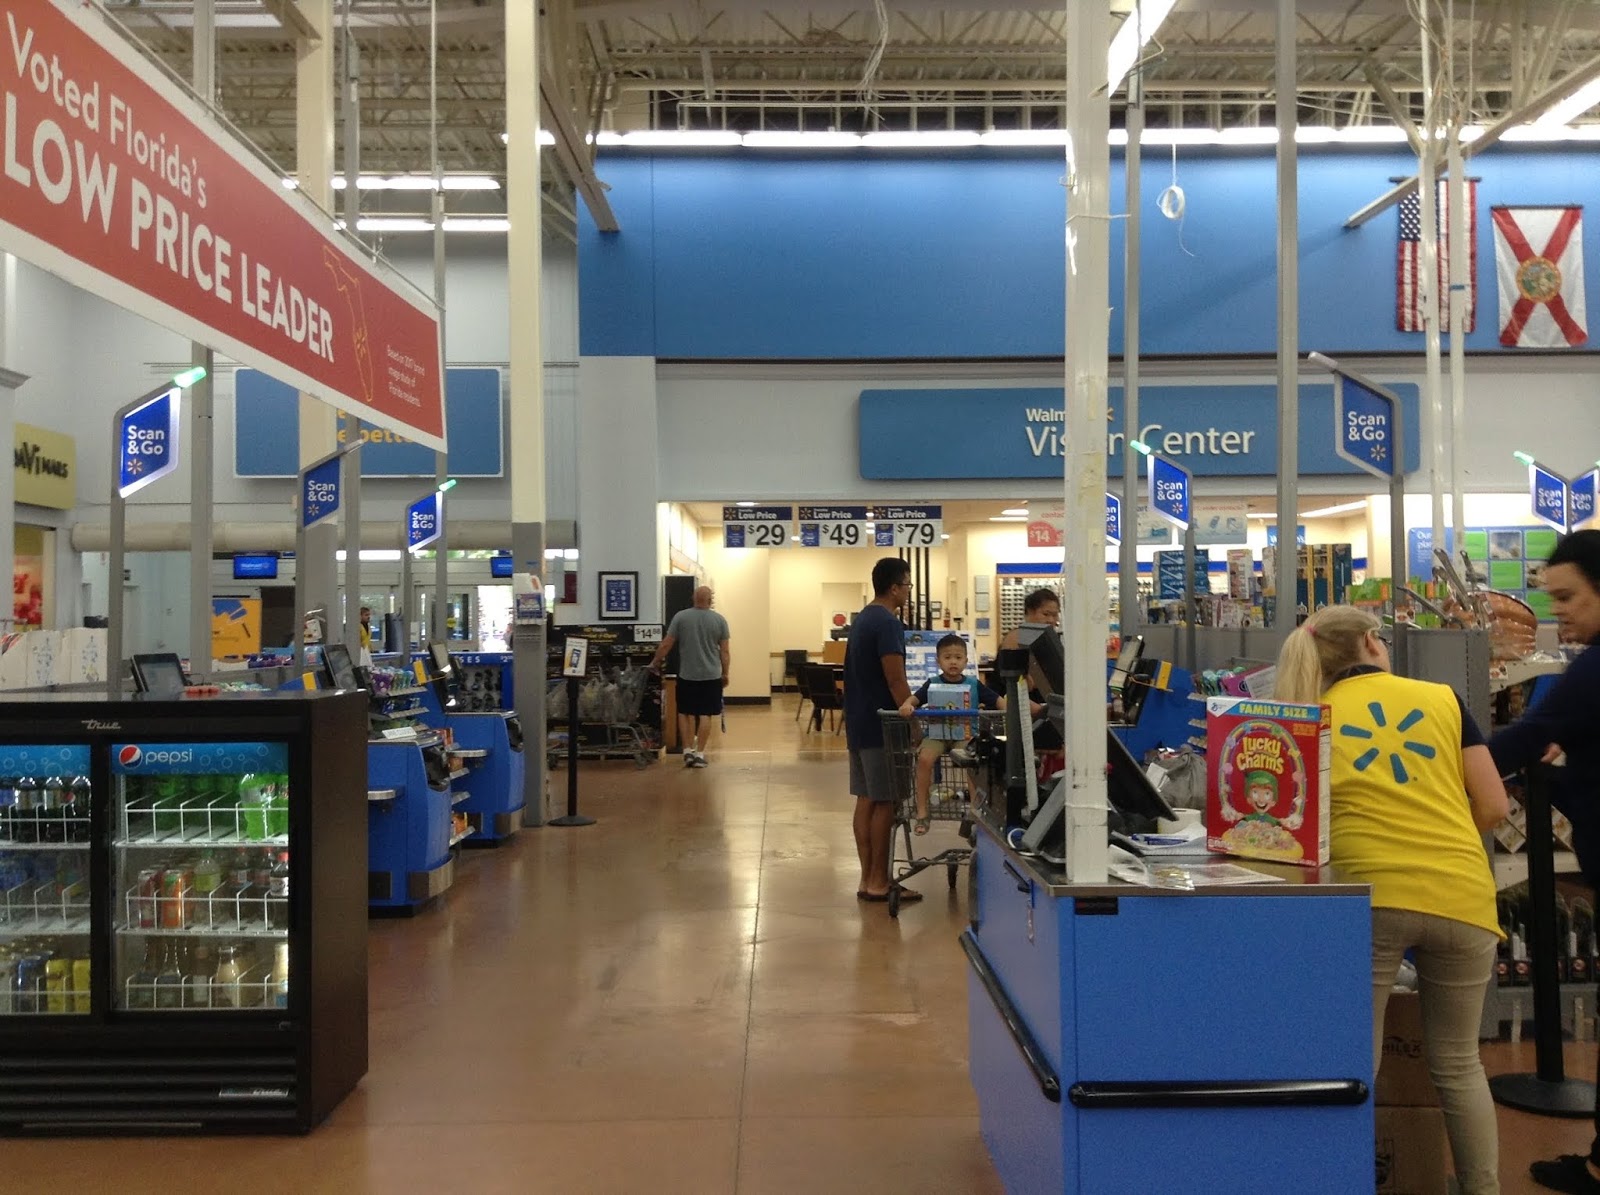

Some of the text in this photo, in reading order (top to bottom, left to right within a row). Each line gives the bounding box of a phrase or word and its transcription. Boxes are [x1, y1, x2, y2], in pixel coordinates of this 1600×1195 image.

[7, 11, 207, 209] Voted Florida's
[4, 91, 335, 363] LOW PRICE LEADER
[1026, 408, 1065, 422] Walm
[1348, 411, 1385, 426] Scan
[128, 425, 165, 440] Scan
[1025, 424, 1255, 457] Vin Center
[308, 480, 335, 491] Scan
[1157, 480, 1183, 490] Scan
[1538, 488, 1562, 498] Scan
[412, 511, 434, 520] Scan
[738, 510, 756, 519] Low
[756, 510, 777, 519] Price
[813, 510, 831, 519] Low
[832, 510, 852, 519] Price
[887, 509, 905, 518] Low
[906, 509, 926, 519] Price
[748, 523, 785, 546] $29
[822, 523, 859, 546] $49
[897, 522, 934, 545] $79
[1029, 530, 1051, 543] $14
[1240, 703, 1280, 716] FAMILY
[1283, 707, 1308, 718] SIZE
[1242, 737, 1281, 758] Lucky
[145, 748, 193, 764] pepsi
[1236, 753, 1284, 774] Charms
